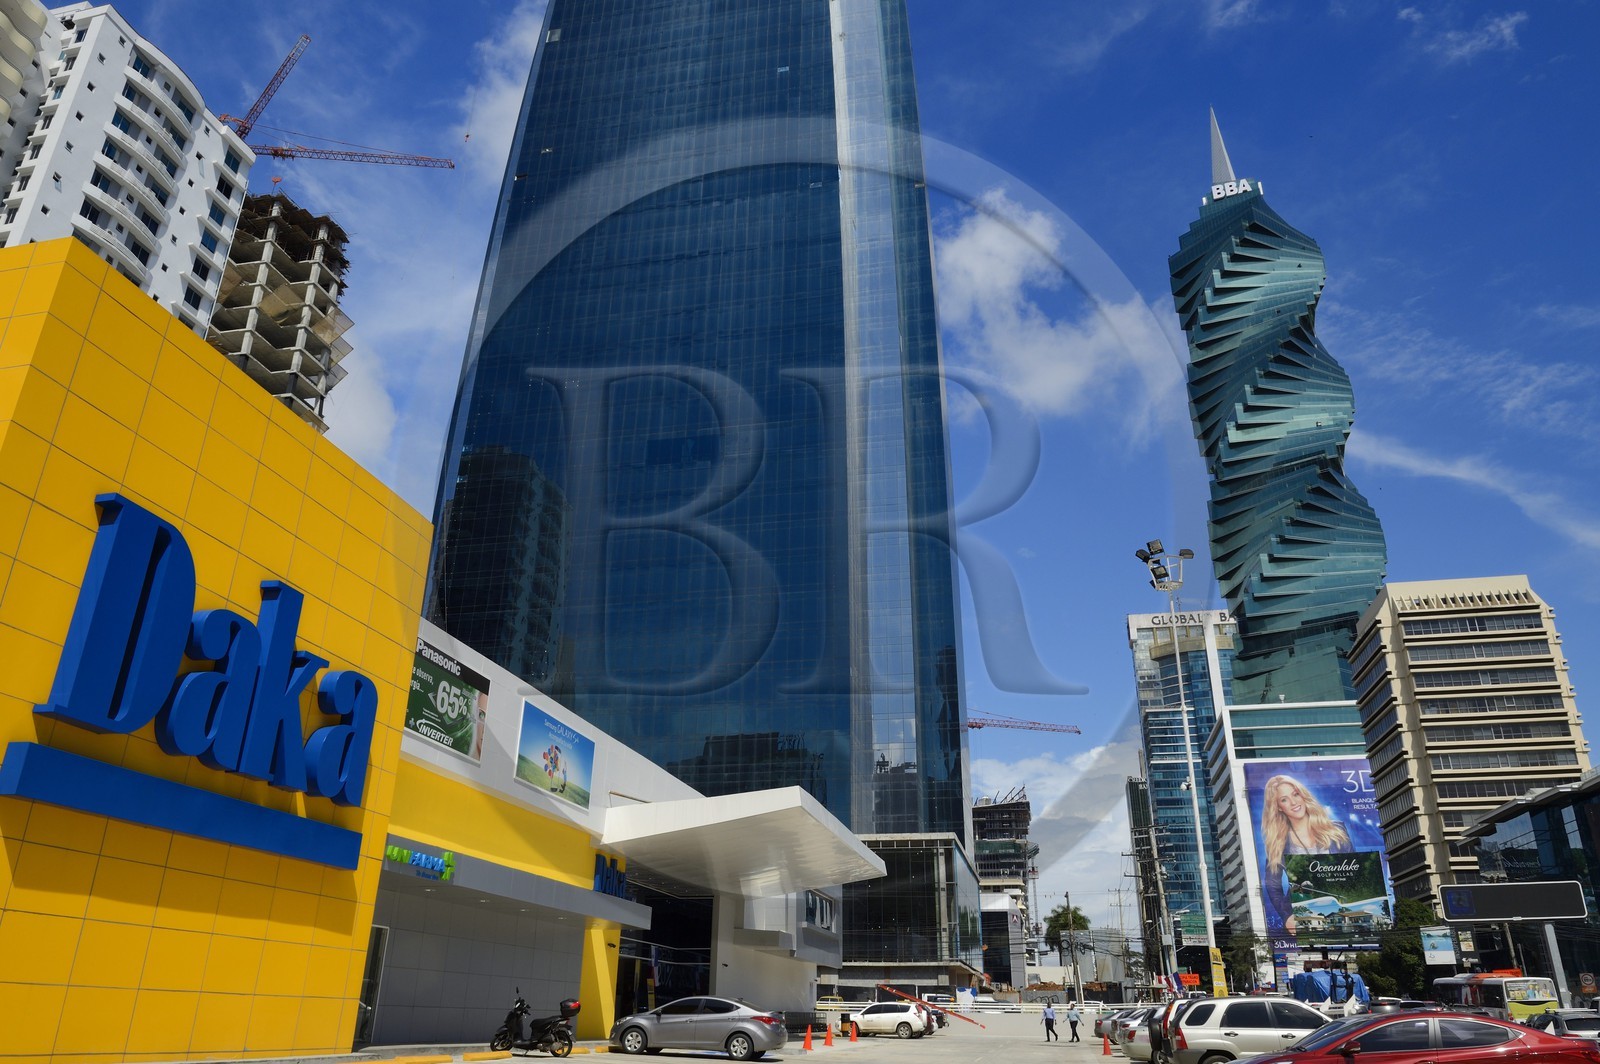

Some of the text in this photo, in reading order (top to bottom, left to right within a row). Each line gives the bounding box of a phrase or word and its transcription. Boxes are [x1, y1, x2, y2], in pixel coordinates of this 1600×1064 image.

[1211, 178, 1252, 200] BBA
[1151, 613, 1204, 626] GLOBAL
[33, 492, 378, 807] Daka
[416, 638, 462, 676] Panasonic
[436, 680, 468, 720] 65%
[418, 724, 454, 747] INVERTER
[1309, 859, 1360, 873] Oceanlake
